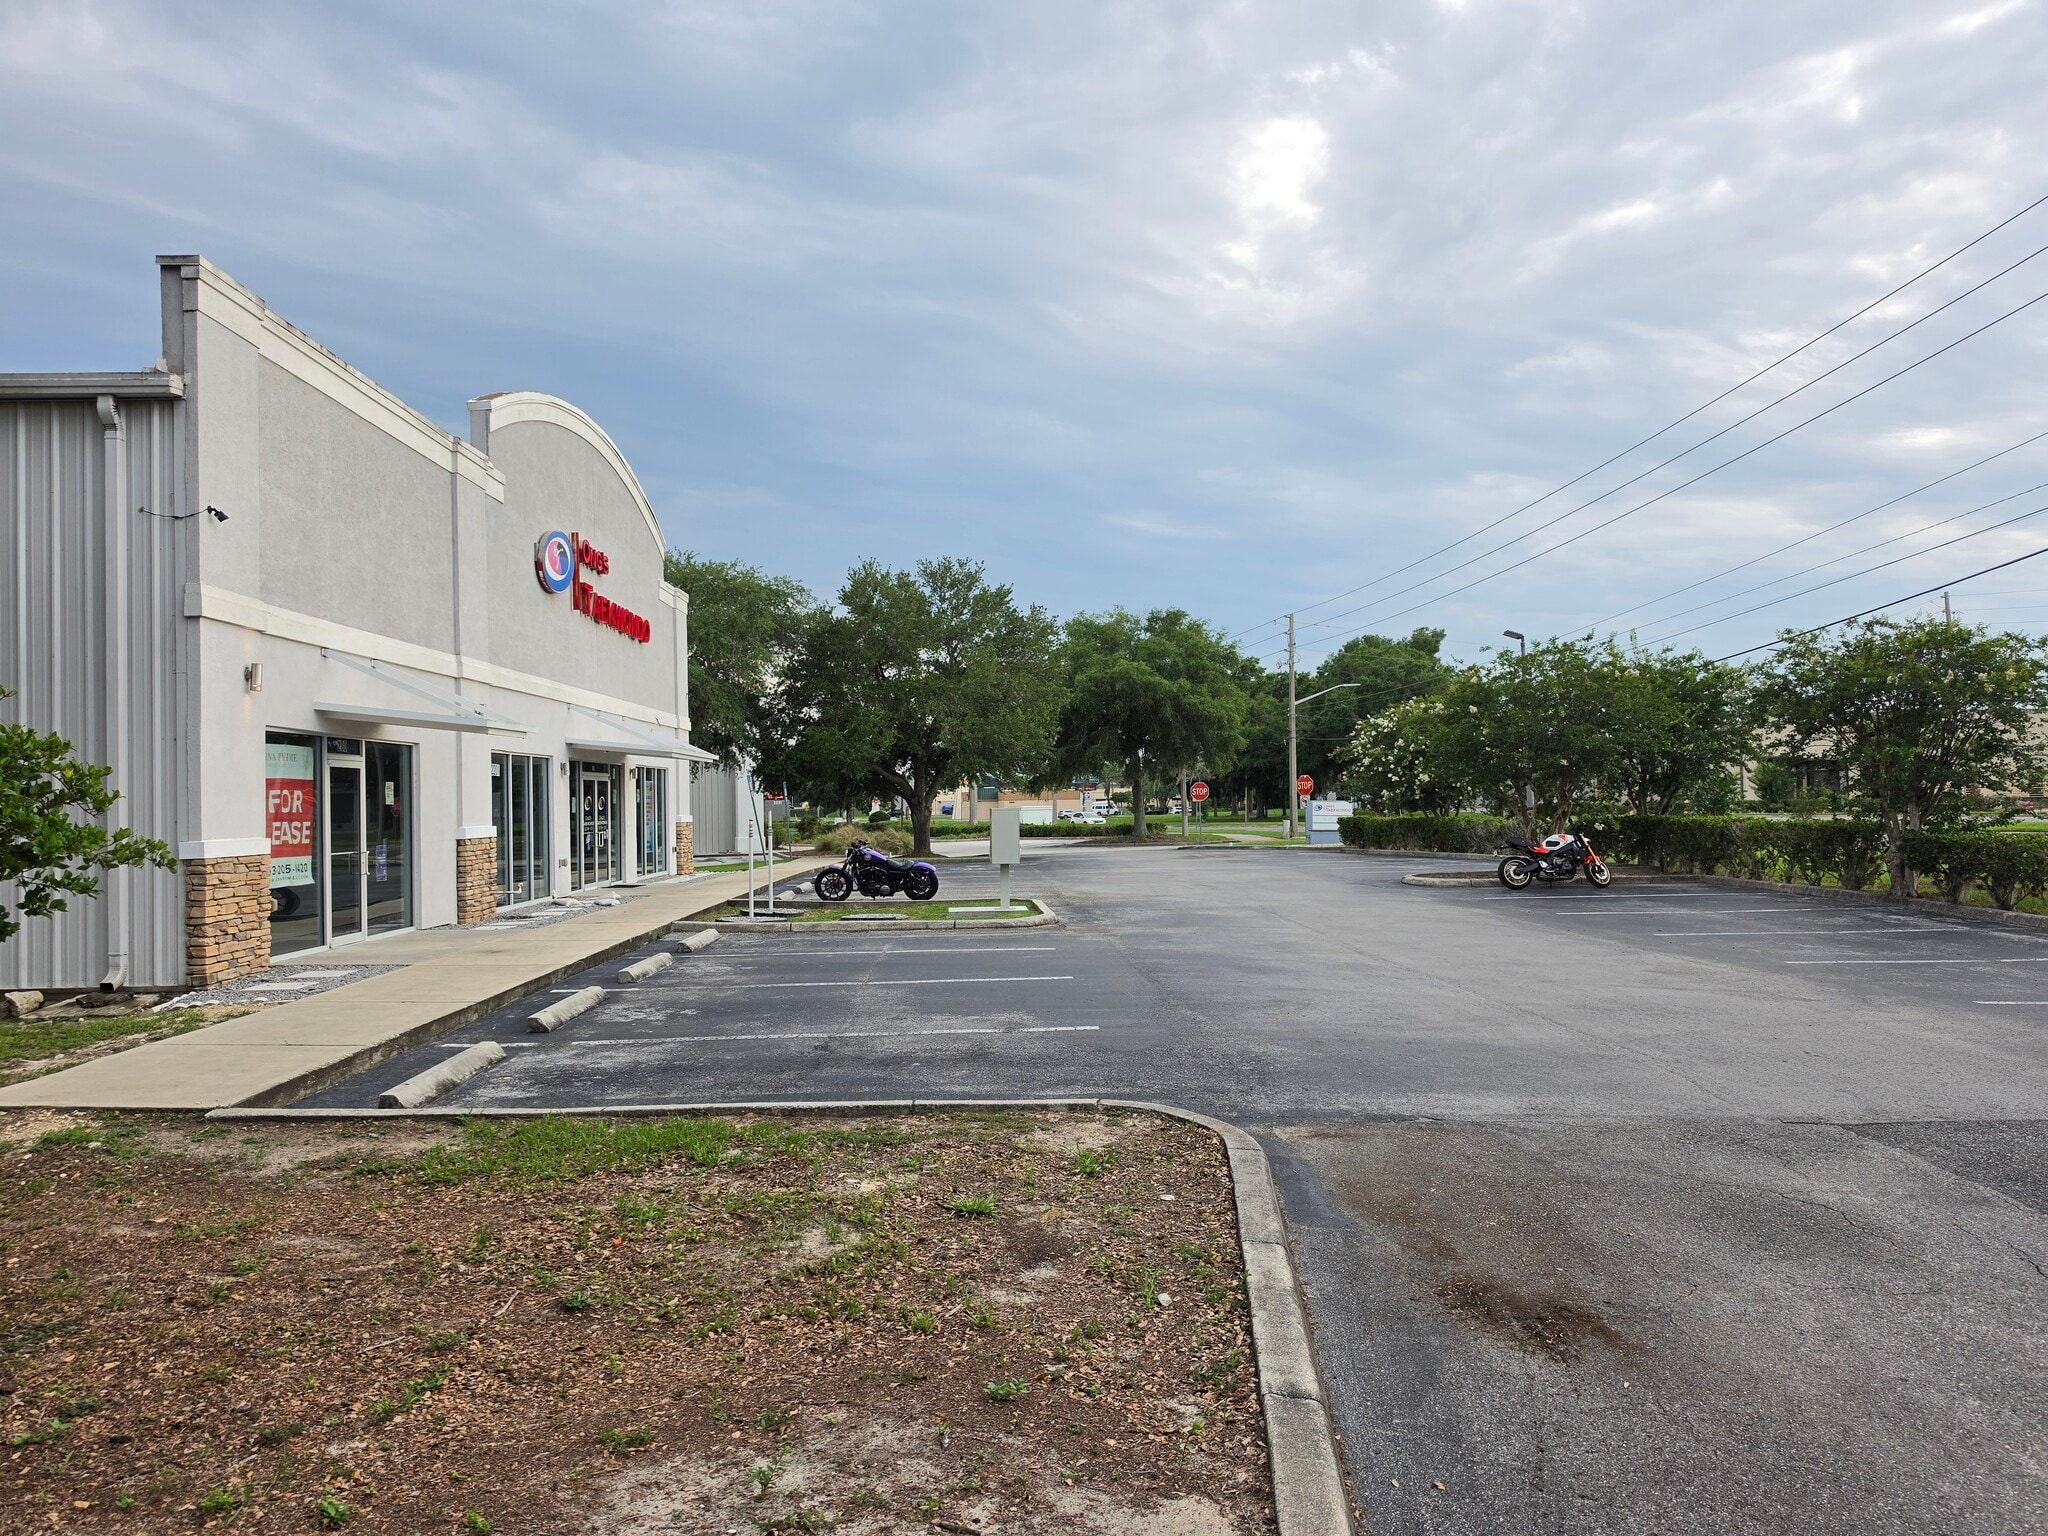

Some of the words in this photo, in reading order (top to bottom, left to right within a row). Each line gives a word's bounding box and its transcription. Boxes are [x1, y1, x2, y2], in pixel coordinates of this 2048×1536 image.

[580, 582, 650, 643] TAEKWONDO
[1192, 788, 1208, 796] STOP
[1297, 781, 1312, 790] STOP
[268, 789, 303, 813] FOR
[271, 821, 311, 845] EASE
[271, 863, 308, 875] 3-205-1420
